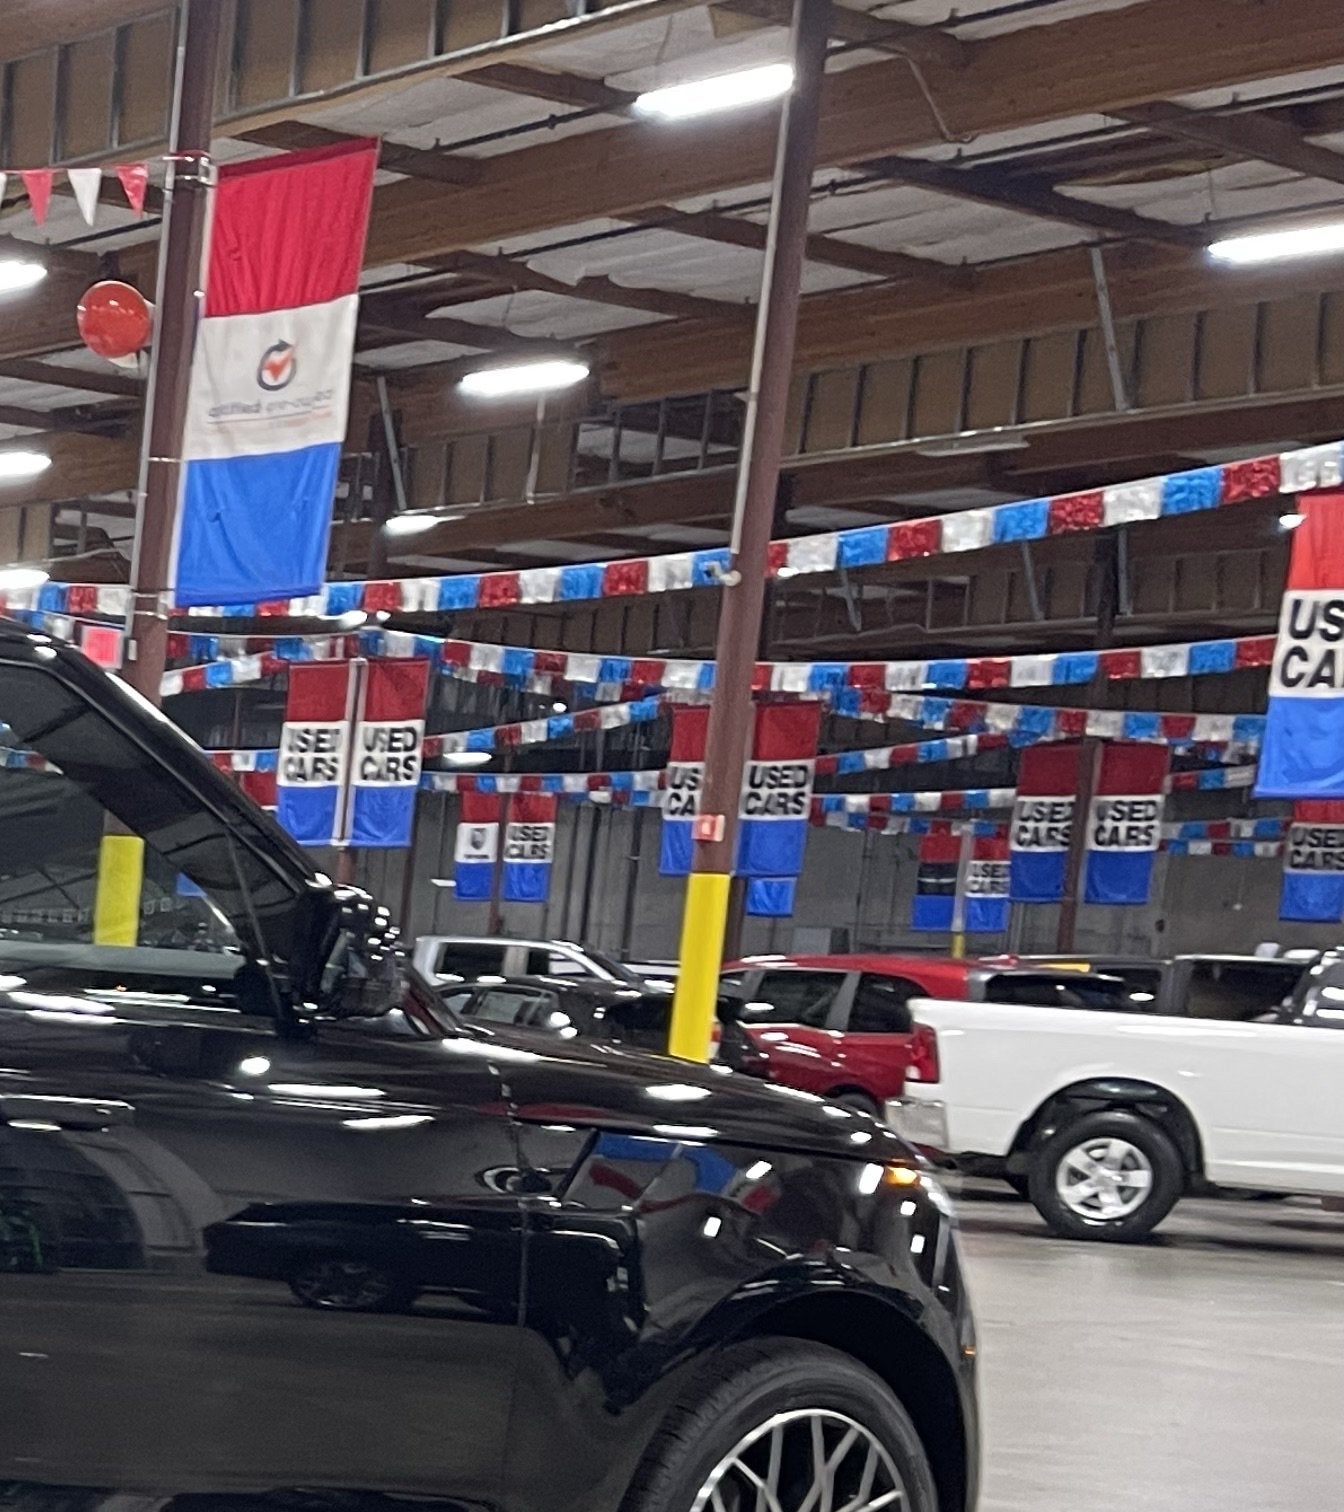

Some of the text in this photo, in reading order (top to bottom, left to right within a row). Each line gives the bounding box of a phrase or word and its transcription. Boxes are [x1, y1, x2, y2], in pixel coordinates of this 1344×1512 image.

[1289, 599, 1344, 642] US
[1281, 645, 1344, 688] CA
[363, 727, 417, 752] USED
[361, 755, 416, 781] CARS
[669, 766, 701, 791] US
[749, 764, 808, 789] USED
[667, 792, 696, 816] CA
[745, 791, 806, 816] CARS
[1094, 824, 1155, 847] CARS
